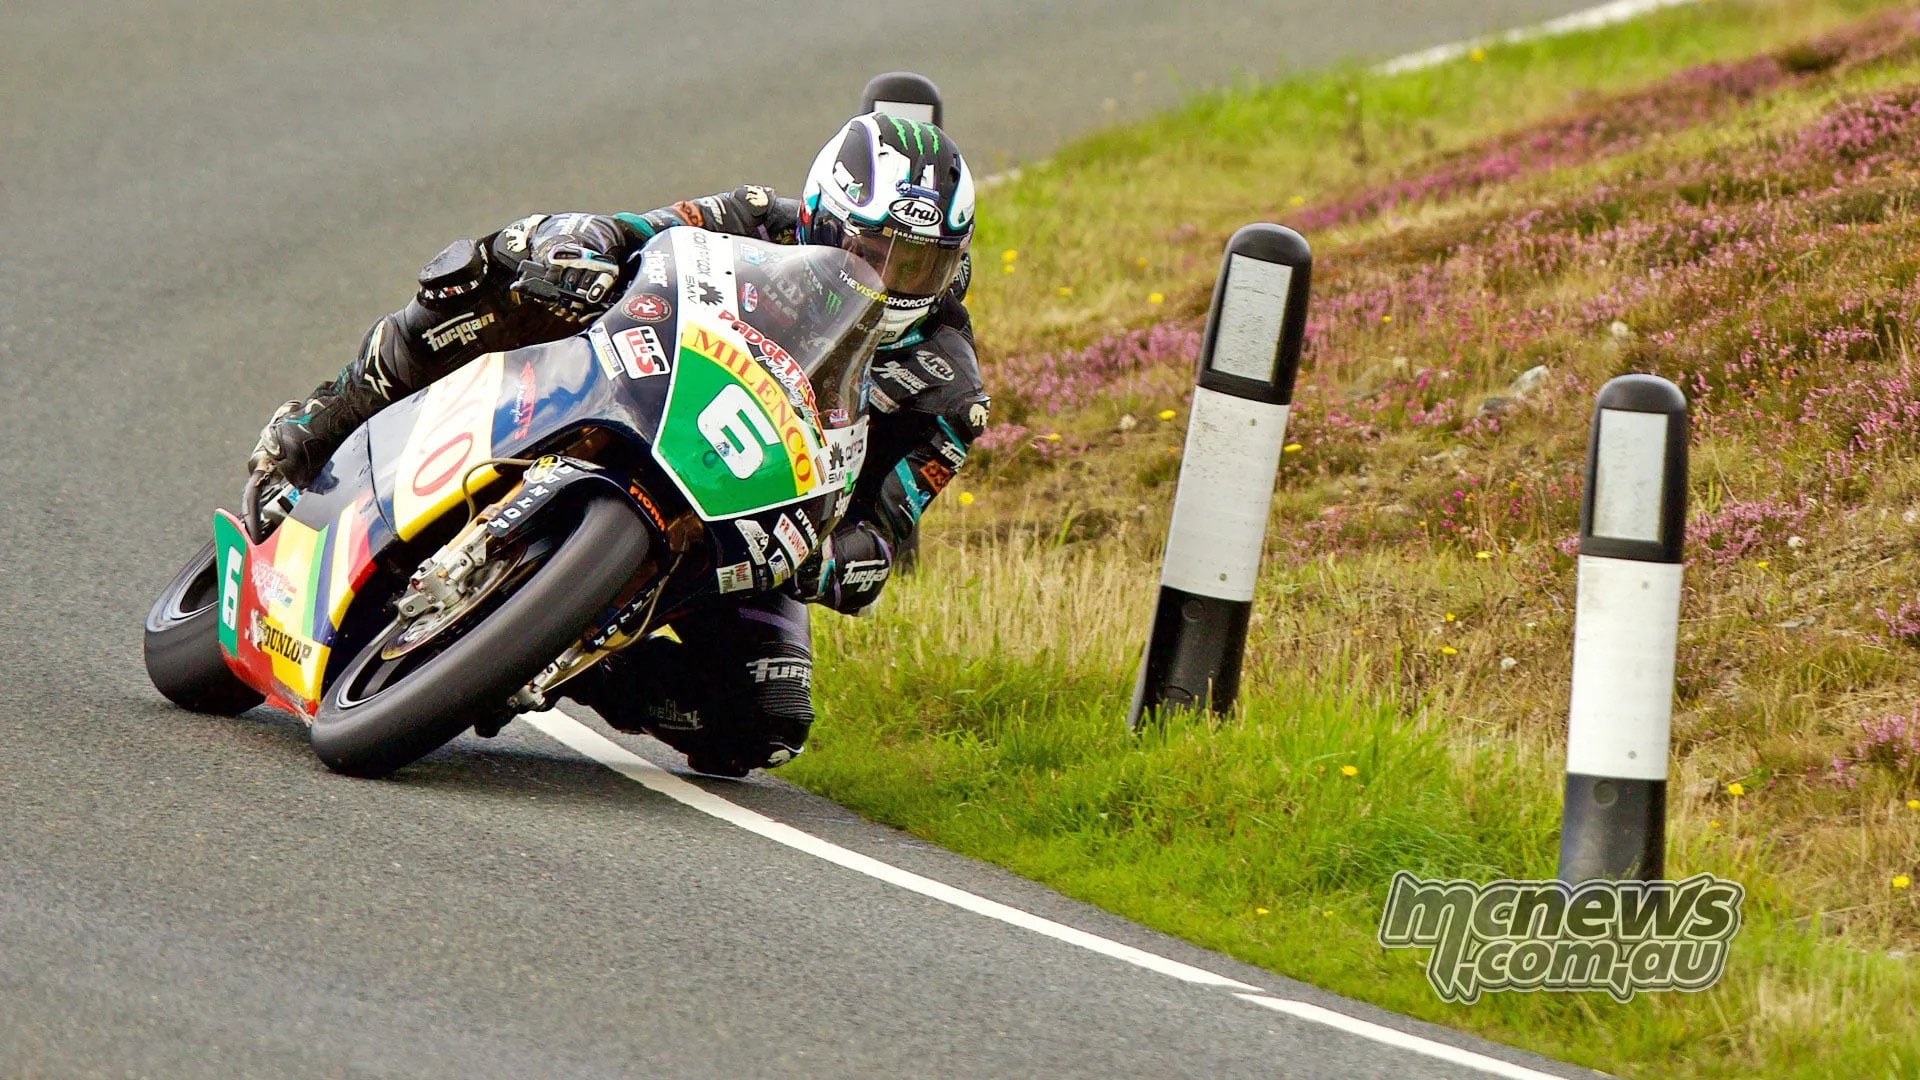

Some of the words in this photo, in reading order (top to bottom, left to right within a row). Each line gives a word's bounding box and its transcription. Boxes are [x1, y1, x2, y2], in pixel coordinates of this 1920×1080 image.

[892, 201, 936, 222] Arai
[893, 229, 940, 244] PARAMOUNT
[685, 274, 698, 305] SMV
[421, 311, 495, 352] furygan
[693, 330, 811, 482] MILENCO
[697, 383, 782, 480] 6
[489, 461, 571, 529] DUNLOP
[222, 545, 243, 631] 6
